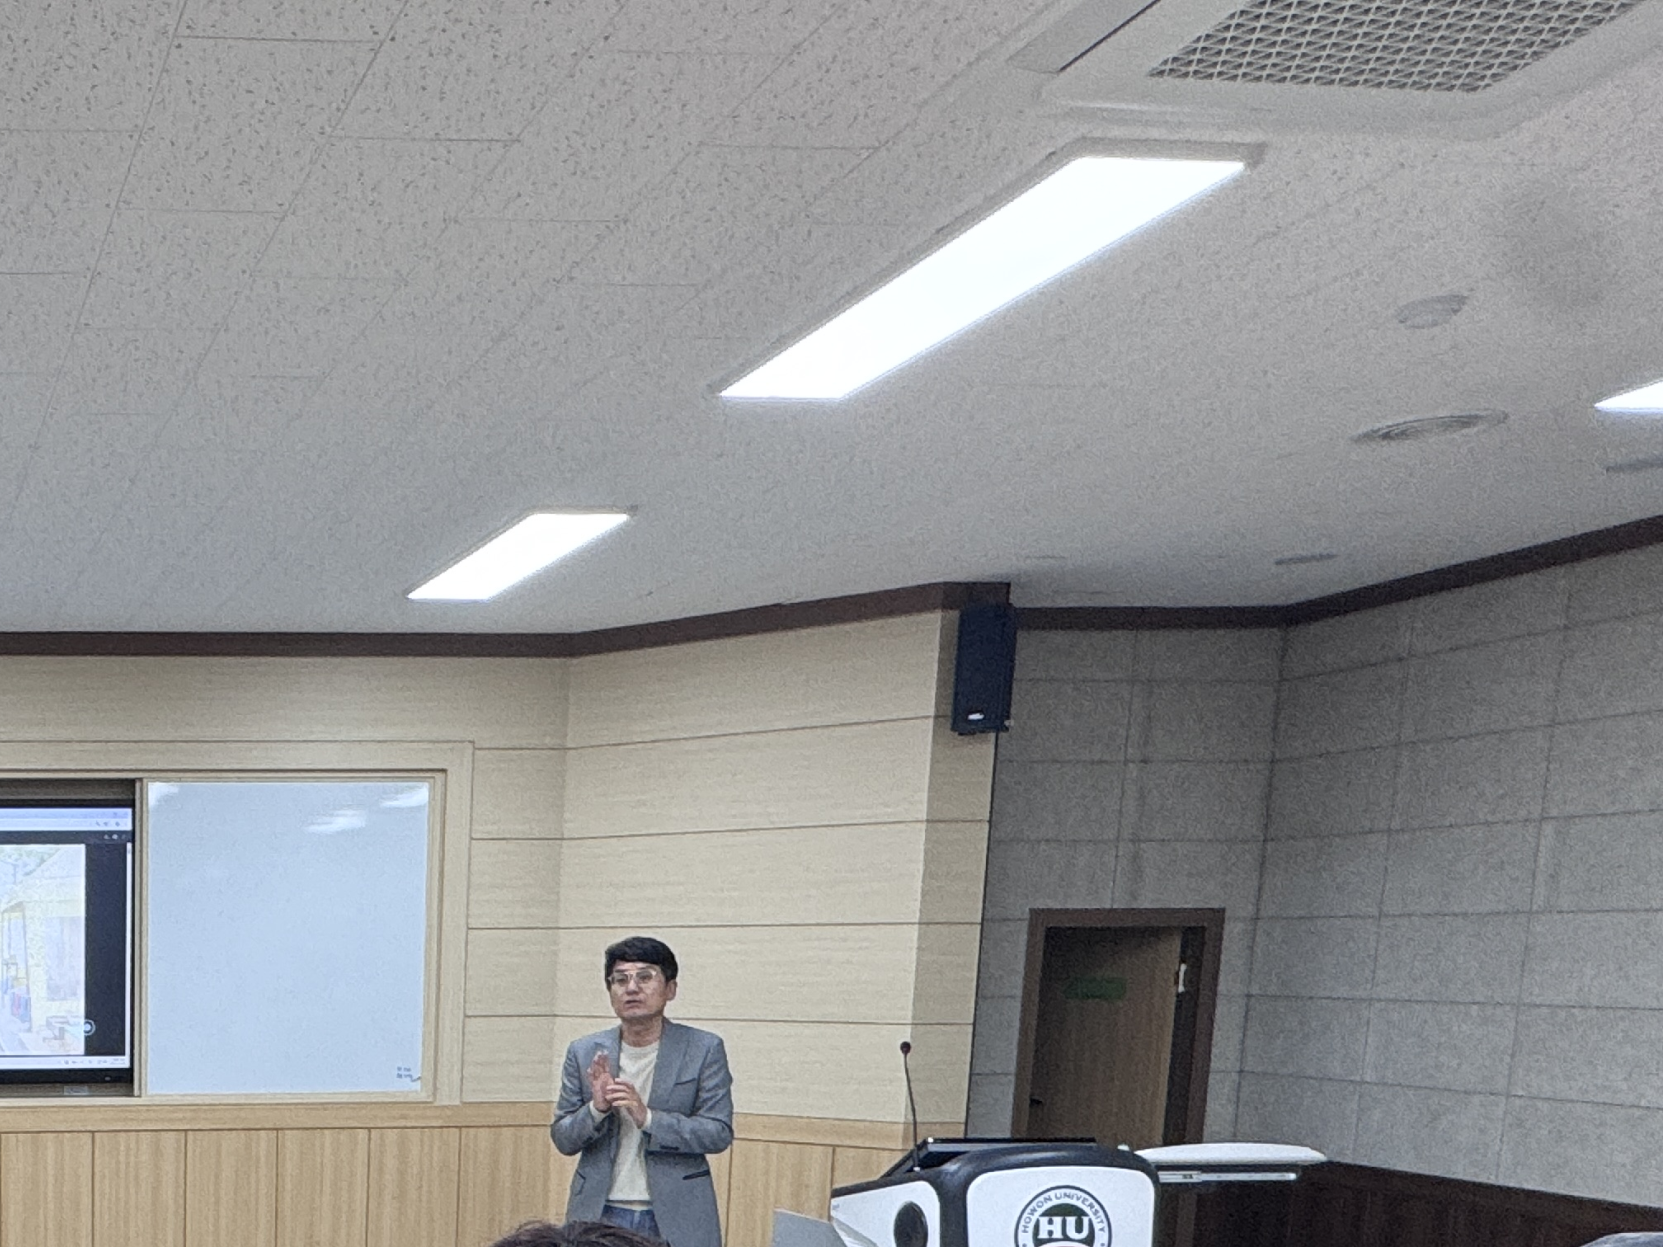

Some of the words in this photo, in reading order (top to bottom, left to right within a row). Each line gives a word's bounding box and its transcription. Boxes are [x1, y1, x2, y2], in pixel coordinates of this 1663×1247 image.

[1021, 1195, 1053, 1234] HOWON
[1054, 1192, 1106, 1233] UNIVERSITY
[1037, 1216, 1090, 1240] HU
